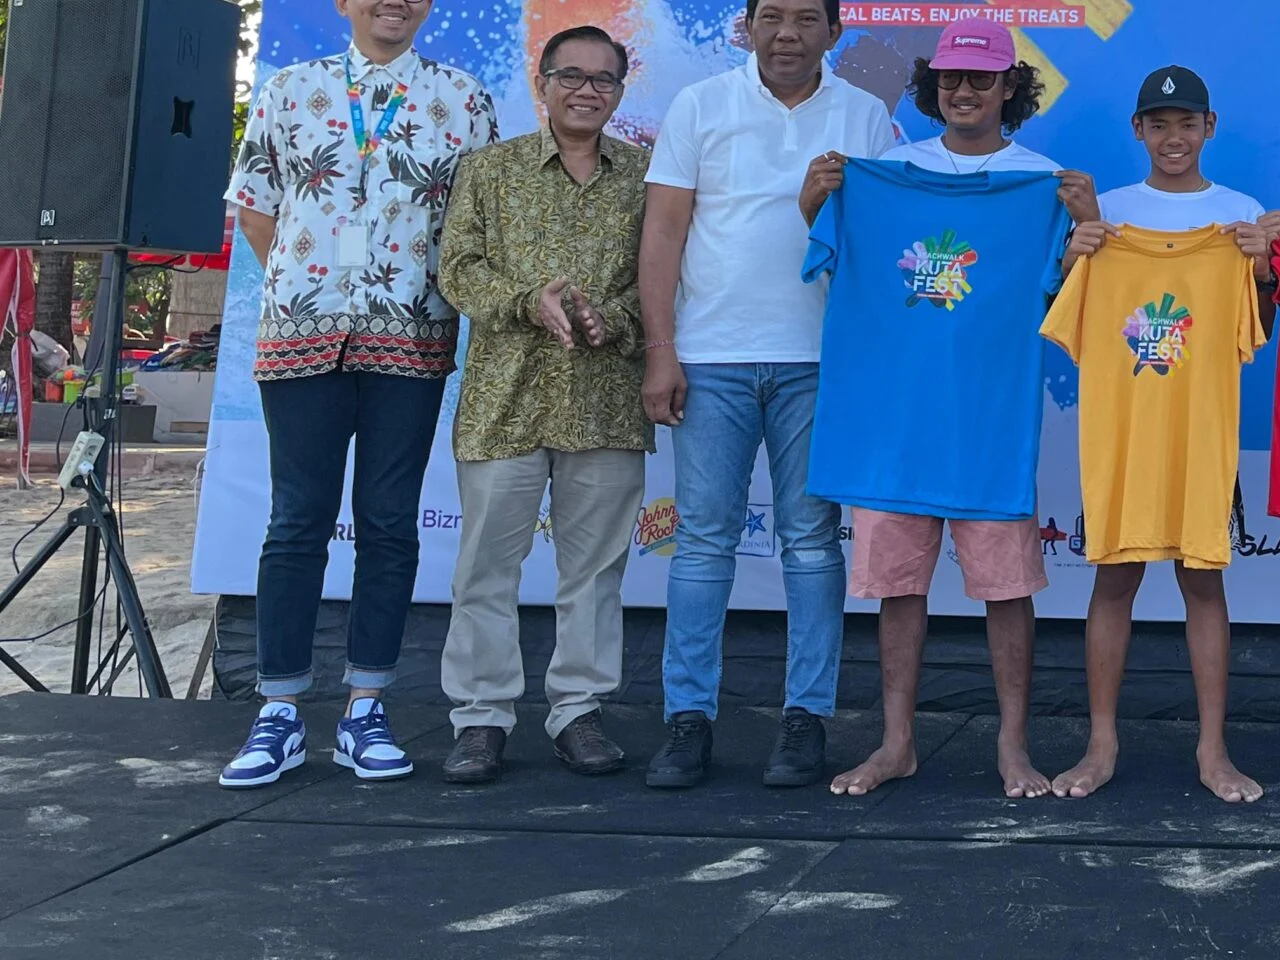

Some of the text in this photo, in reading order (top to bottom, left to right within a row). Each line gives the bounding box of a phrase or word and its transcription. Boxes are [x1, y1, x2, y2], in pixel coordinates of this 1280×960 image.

[839, 7, 867, 22] CAL
[872, 8, 925, 23] BEATS,
[984, 9, 1013, 23] THE
[1018, 9, 1079, 23] TREATS
[915, 259, 962, 277] KUTA
[913, 276, 963, 294] FEST
[1139, 325, 1183, 343] KUTA
[1137, 342, 1183, 361] FEST
